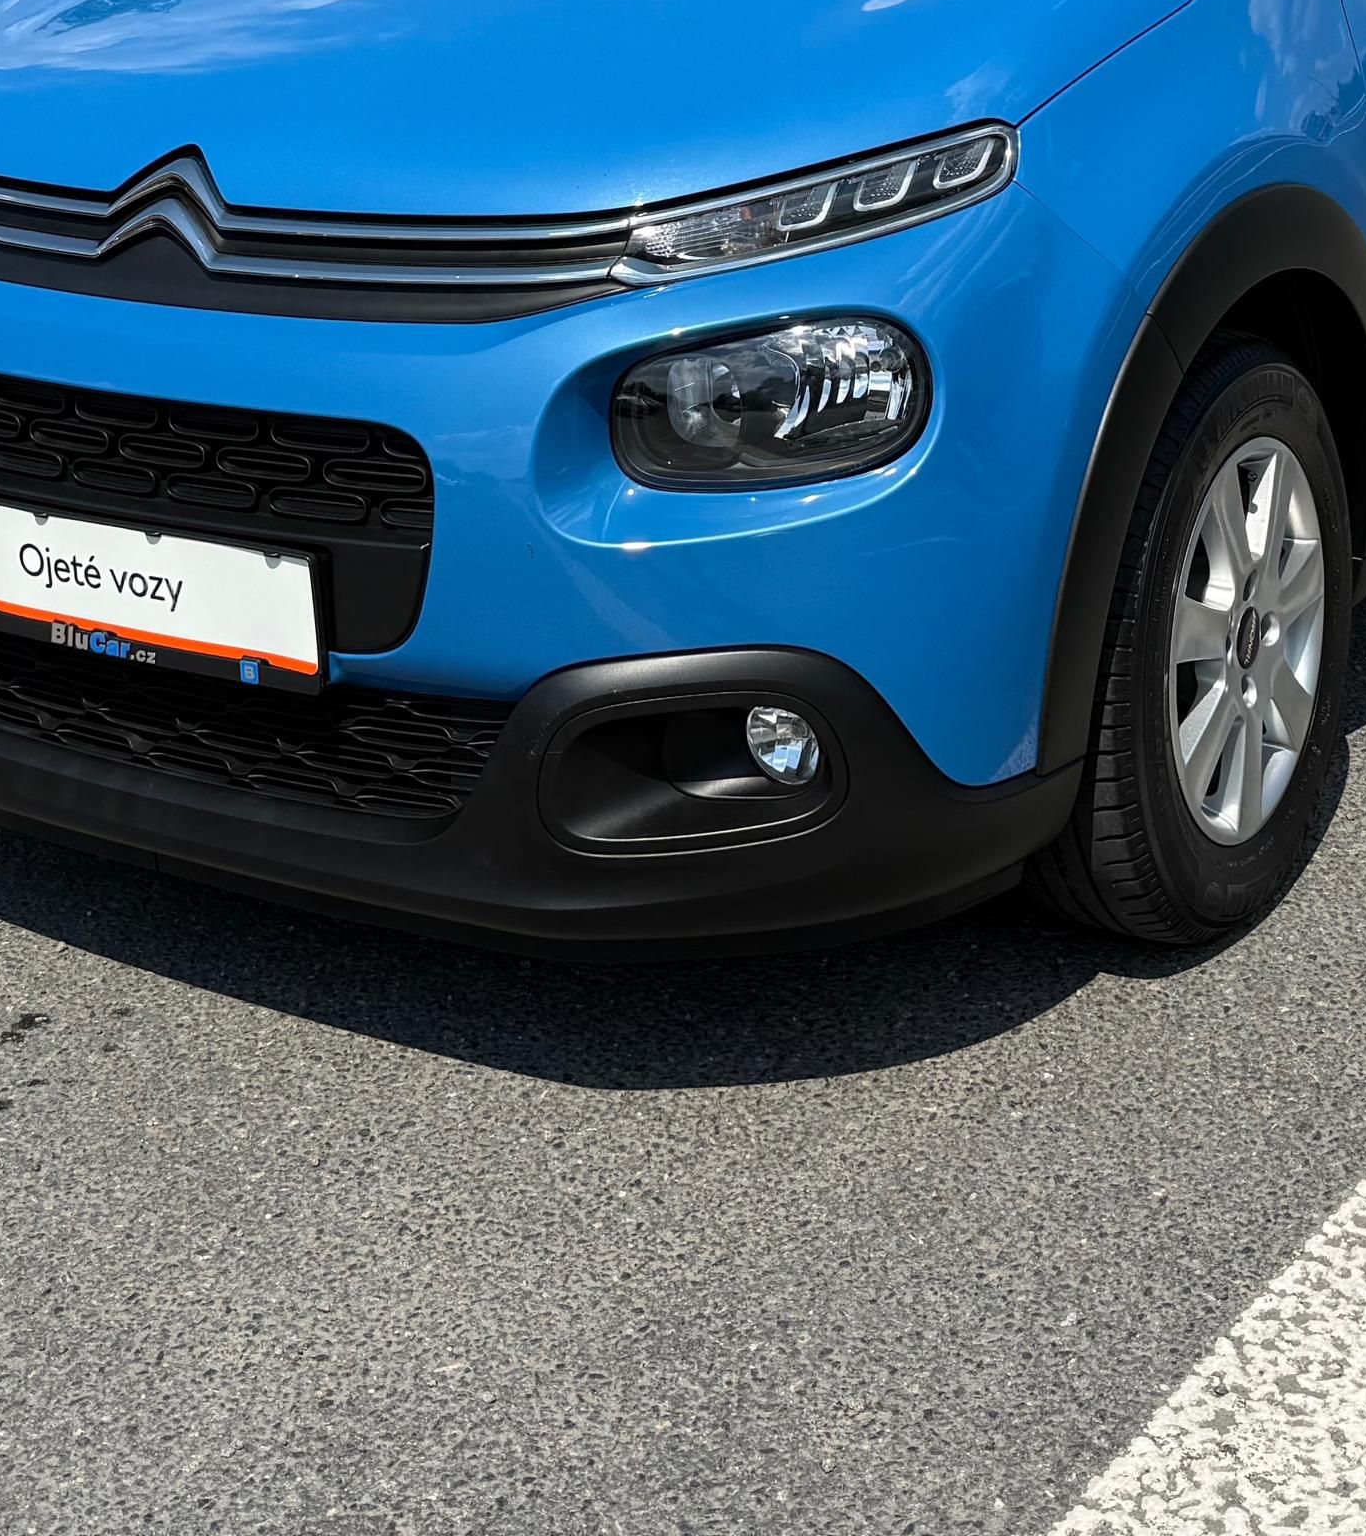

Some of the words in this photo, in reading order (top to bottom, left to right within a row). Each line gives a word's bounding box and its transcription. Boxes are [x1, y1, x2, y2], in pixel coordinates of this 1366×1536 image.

[19, 543, 102, 589] Ojeté
[109, 568, 183, 612] vozy
[51, 622, 156, 664] BluCar.cz
